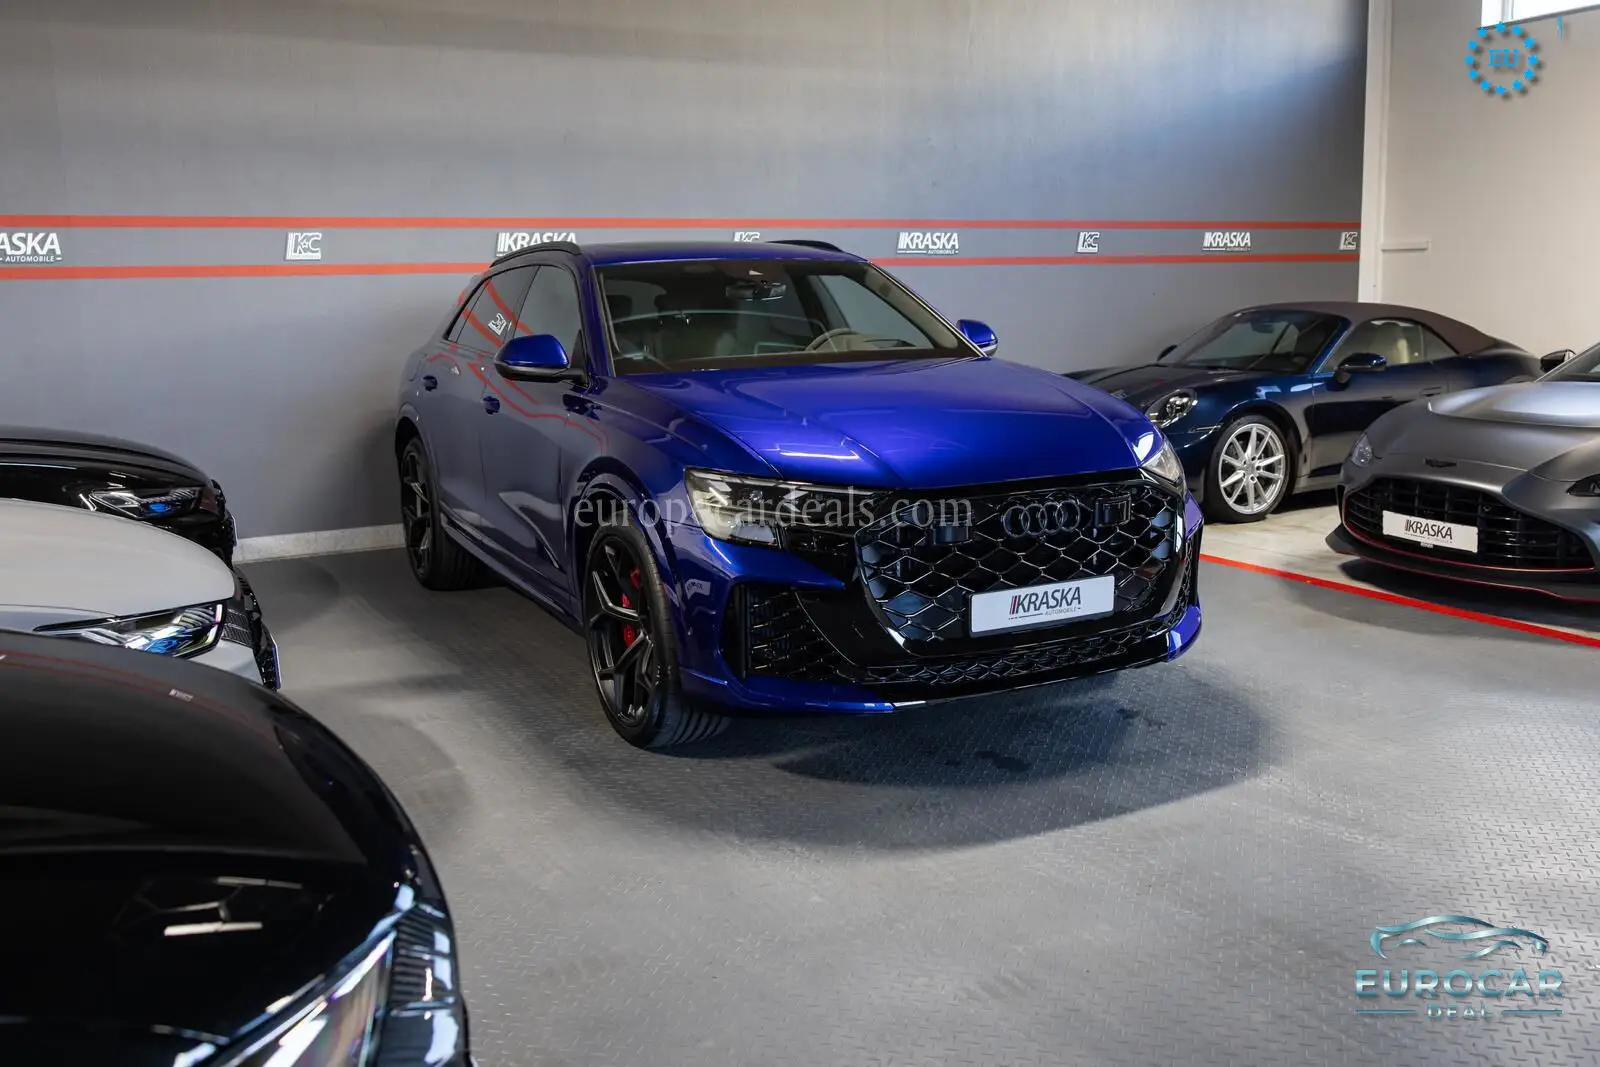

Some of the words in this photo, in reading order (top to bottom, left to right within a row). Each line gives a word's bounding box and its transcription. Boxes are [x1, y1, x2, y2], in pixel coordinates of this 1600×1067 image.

[903, 232, 959, 249] KRASKA
[1208, 232, 1251, 247] KRASKA
[5, 255, 55, 263] AUTOMOBILE
[1408, 520, 1453, 540] KRASKA
[1015, 586, 1082, 614] KRASKA
[1044, 607, 1077, 616] AUTOMOBILE
